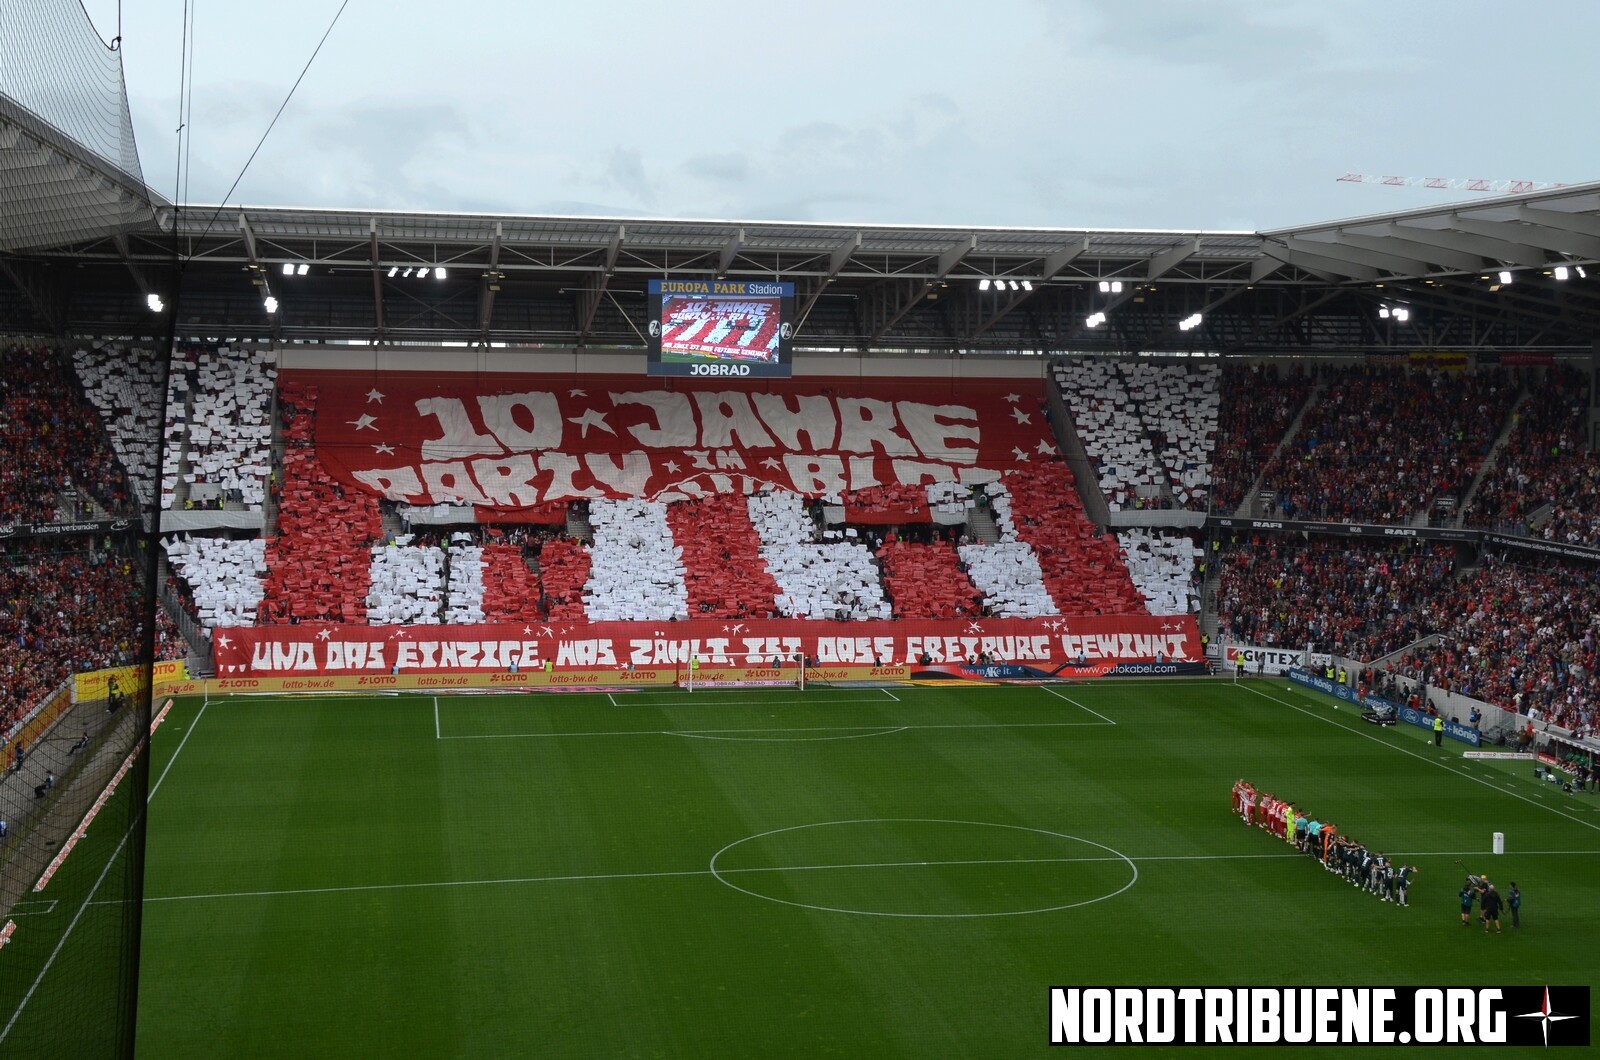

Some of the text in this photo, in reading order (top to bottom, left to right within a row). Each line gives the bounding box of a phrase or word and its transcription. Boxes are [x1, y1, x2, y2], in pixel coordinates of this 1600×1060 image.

[660, 282, 783, 295] EUROPA PARK Stadion
[690, 364, 750, 376] JOBRAD
[414, 390, 980, 465] 10 JAHRE
[352, 449, 653, 507] PARTY
[683, 449, 747, 470] IM
[62, 522, 99, 532] verbunden
[1252, 521, 1283, 529] RAFI
[324, 641, 385, 670] DAS
[555, 639, 617, 666] WAS
[816, 636, 894, 664] DASS
[905, 635, 1050, 664] FREIBURG
[1061, 633, 1188, 660] GEWINNT
[1243, 650, 1303, 666] GUTEX
[755, 669, 781, 678] LOTTO
[880, 667, 905, 676] LOTTO
[1074, 663, 1177, 675] www.autokabel.com
[501, 673, 528, 682] LOTTO
[549, 673, 598, 683] lotto-bw.de
[631, 671, 656, 680] LOTTO
[804, 670, 848, 679] otto-bw.de
[231, 679, 259, 688] LOTTO
[282, 679, 335, 689] lotto-bw.de
[369, 676, 397, 684] LOTTO
[417, 676, 468, 686] lotto-bw.de
[1290, 671, 1309, 684] ernst
[1313, 677, 1333, 693] könig
[1453, 727, 1477, 743] könig
